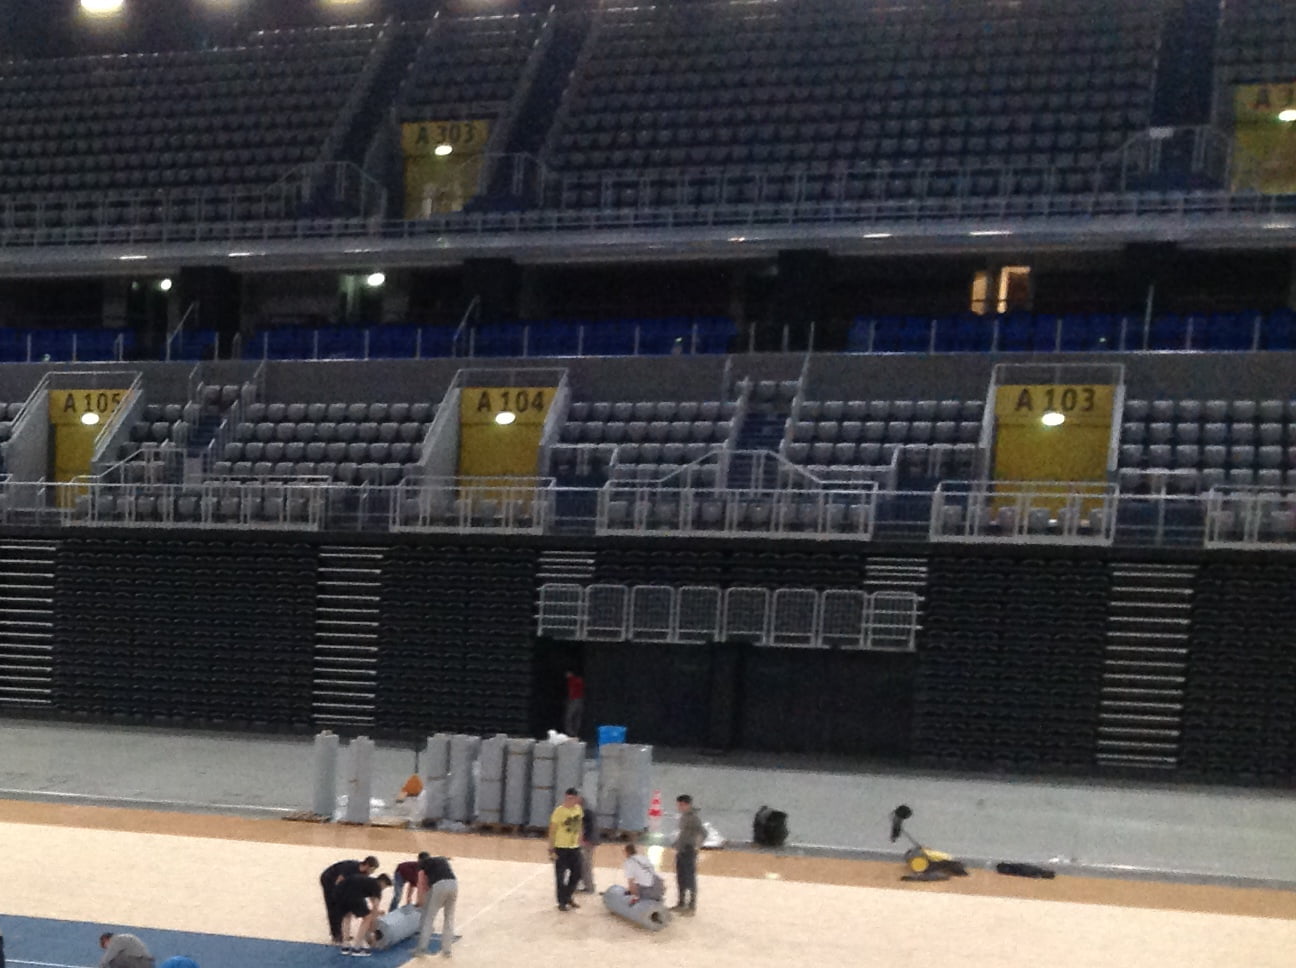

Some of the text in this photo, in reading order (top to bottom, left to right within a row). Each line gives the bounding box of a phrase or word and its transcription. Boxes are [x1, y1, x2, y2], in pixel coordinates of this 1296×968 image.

[415, 123, 475, 145] A 303
[64, 392, 122, 413] A 105
[477, 390, 544, 413] A 104
[1014, 387, 1096, 412] A 103
